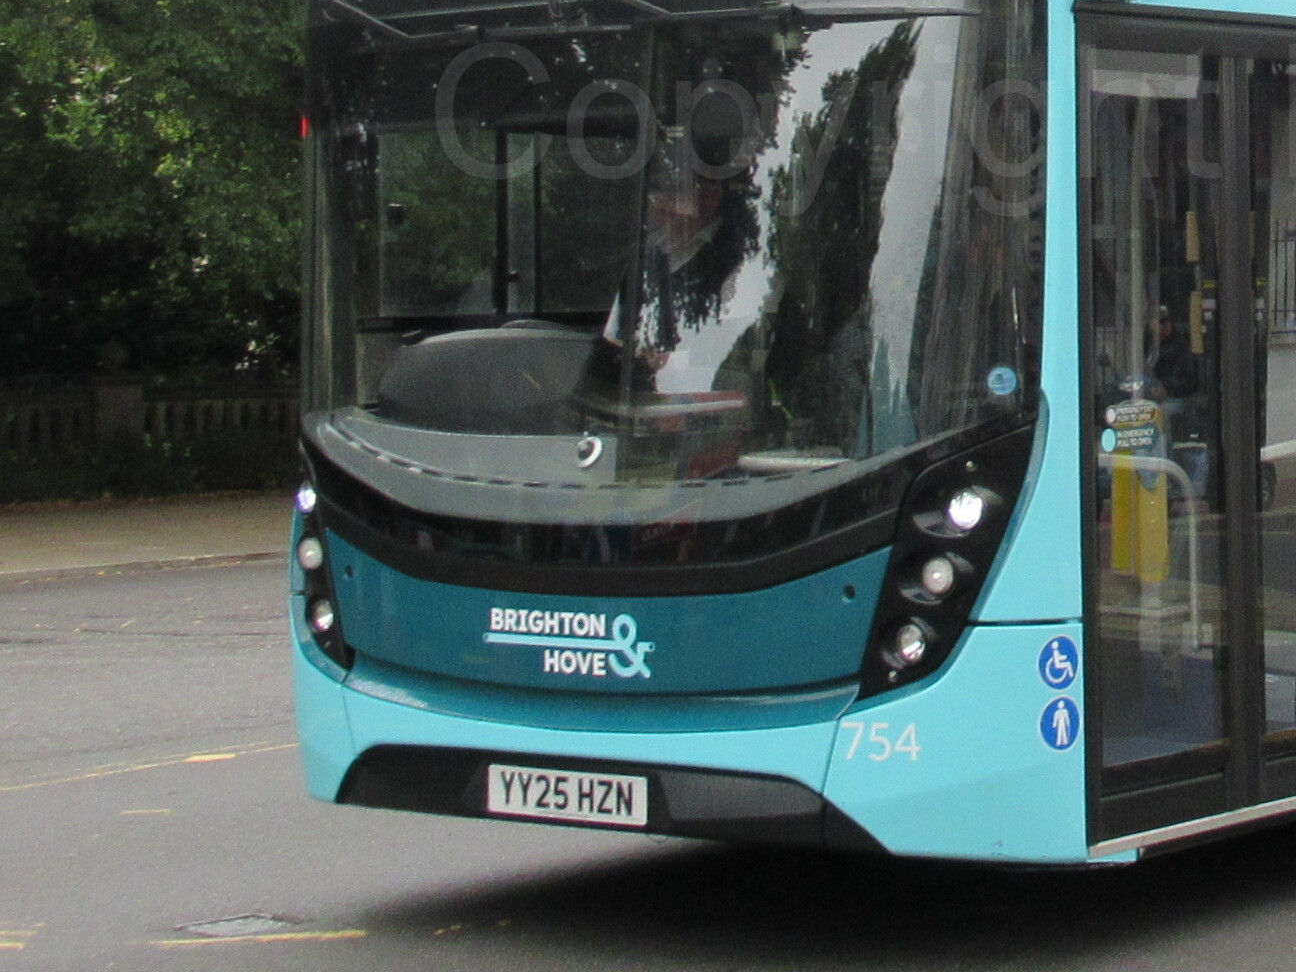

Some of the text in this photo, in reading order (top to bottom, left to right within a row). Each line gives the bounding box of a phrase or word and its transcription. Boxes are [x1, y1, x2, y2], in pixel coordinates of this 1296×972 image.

[489, 606, 607, 637] BRIGHTON
[543, 649, 607, 677] HOVE
[839, 722, 922, 762] 754
[500, 770, 634, 817] YY25 HZN
